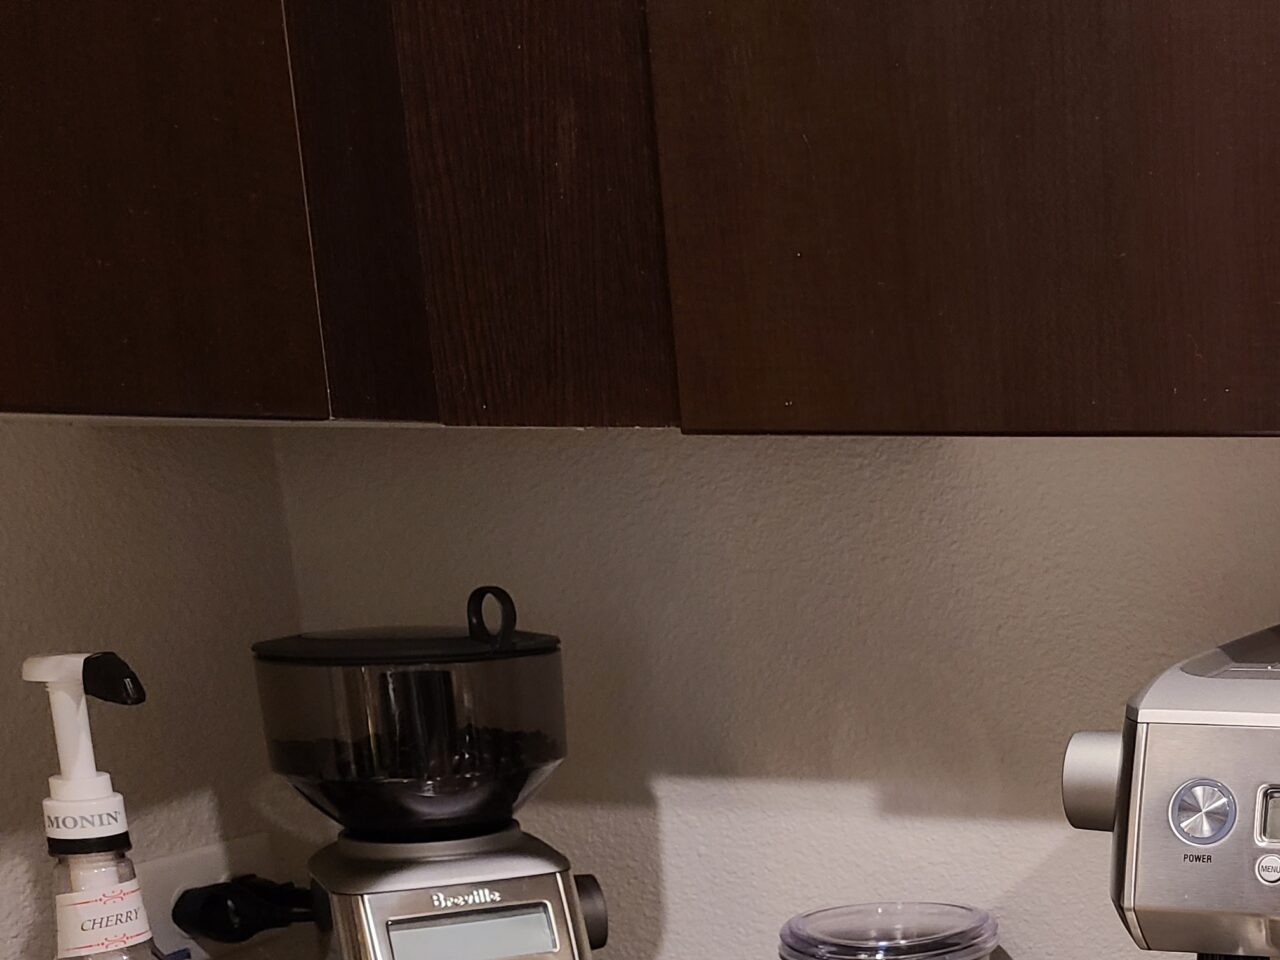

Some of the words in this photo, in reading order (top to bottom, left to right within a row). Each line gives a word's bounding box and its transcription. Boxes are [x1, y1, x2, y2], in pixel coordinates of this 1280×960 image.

[47, 811, 120, 829] MONIN
[1183, 853, 1212, 863] POWER
[432, 887, 502, 909] Breville
[80, 907, 141, 932] CHERRY
